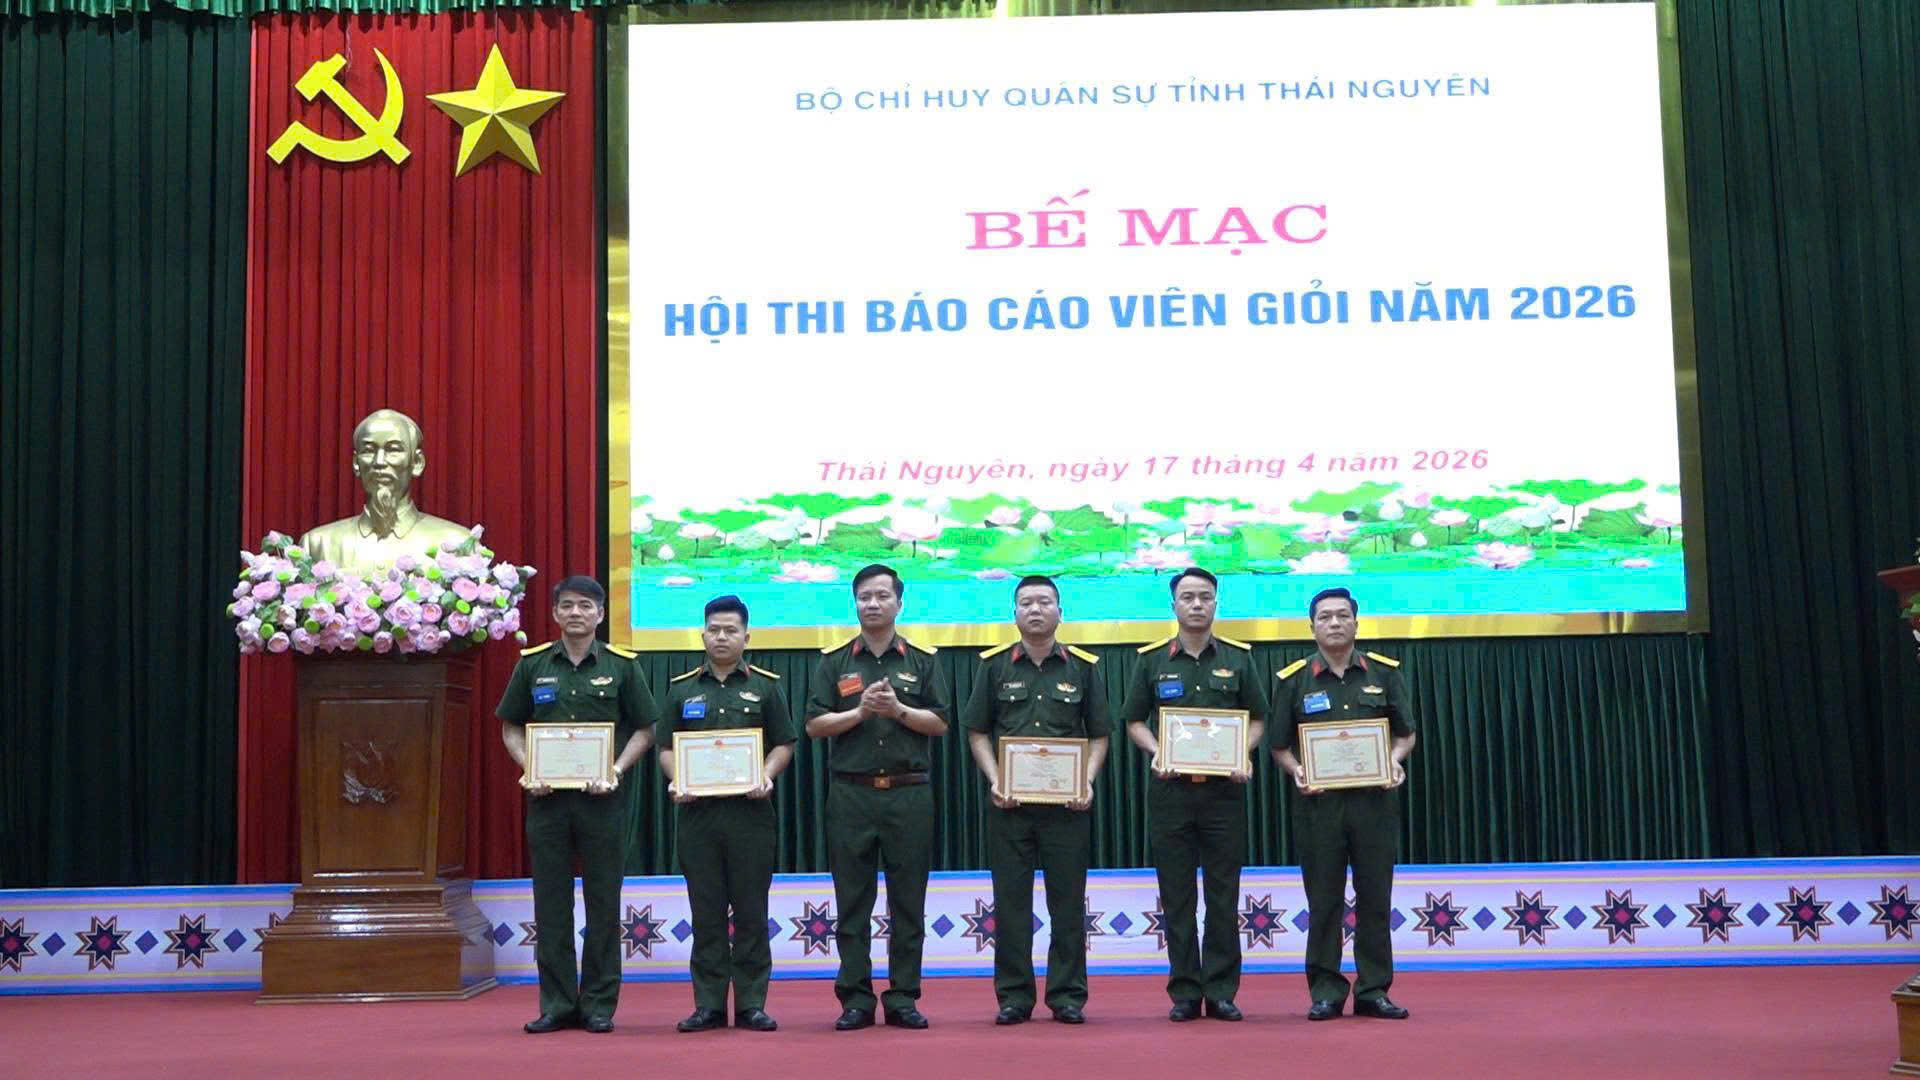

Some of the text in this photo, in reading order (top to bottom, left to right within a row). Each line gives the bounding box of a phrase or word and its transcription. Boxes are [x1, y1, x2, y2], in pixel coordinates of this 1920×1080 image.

[795, 87, 843, 114] BỘ
[923, 87, 990, 108] HUY
[1004, 80, 1099, 107] QUÂN
[1112, 82, 1159, 109] SỰ
[1259, 76, 1335, 101] THÁI
[1348, 73, 1491, 98] NGUYÊN
[965, 188, 1328, 256] BẾ MẠC
[664, 278, 1637, 344] HỘI THI BÁO CÁO VIÊN GIỎI NĂM 2026
[818, 460, 887, 481] Thái
[1049, 457, 1129, 482] ngày
[1144, 456, 1179, 476] 17
[1191, 454, 1286, 479] tháng
[1297, 453, 1316, 472] 4
[1328, 452, 1399, 472] năm
[1411, 450, 1489, 470] 2026
